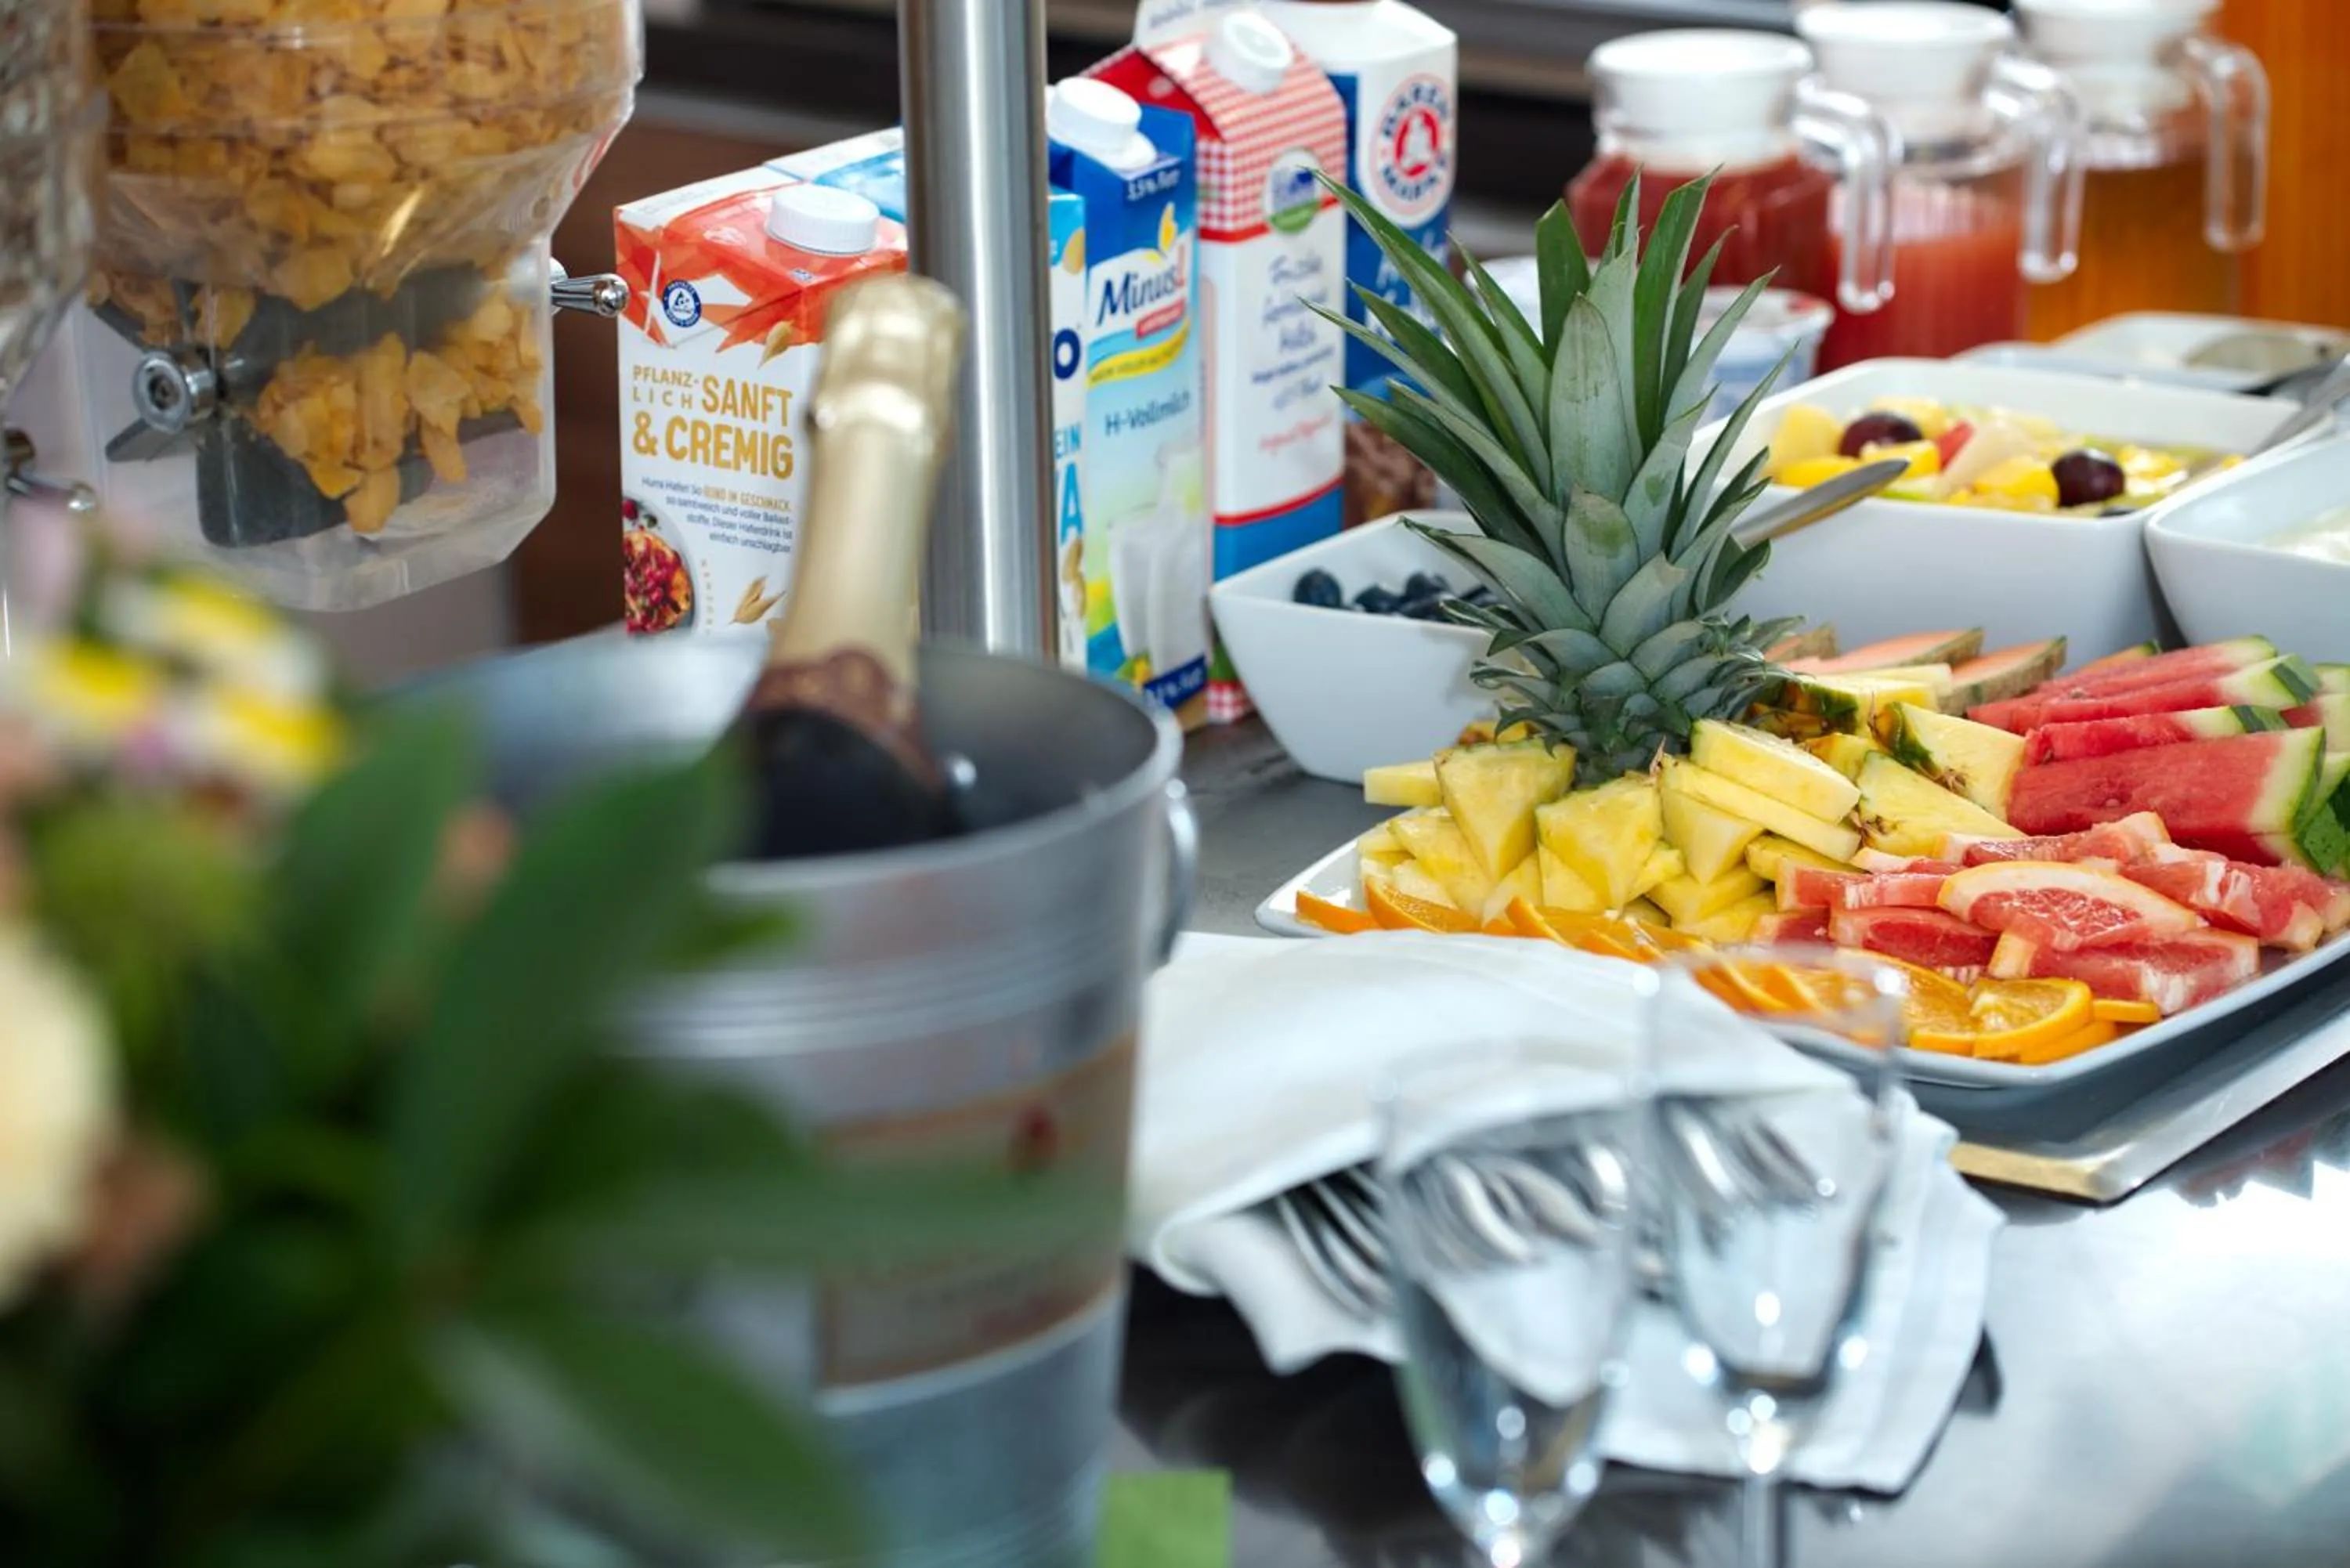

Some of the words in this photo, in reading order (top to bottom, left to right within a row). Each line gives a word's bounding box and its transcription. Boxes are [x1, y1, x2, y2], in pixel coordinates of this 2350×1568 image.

[632, 364, 700, 388] PFLANZ-
[702, 374, 794, 428] SANFT
[632, 410, 659, 457] &
[665, 415, 794, 480] CREMIG
